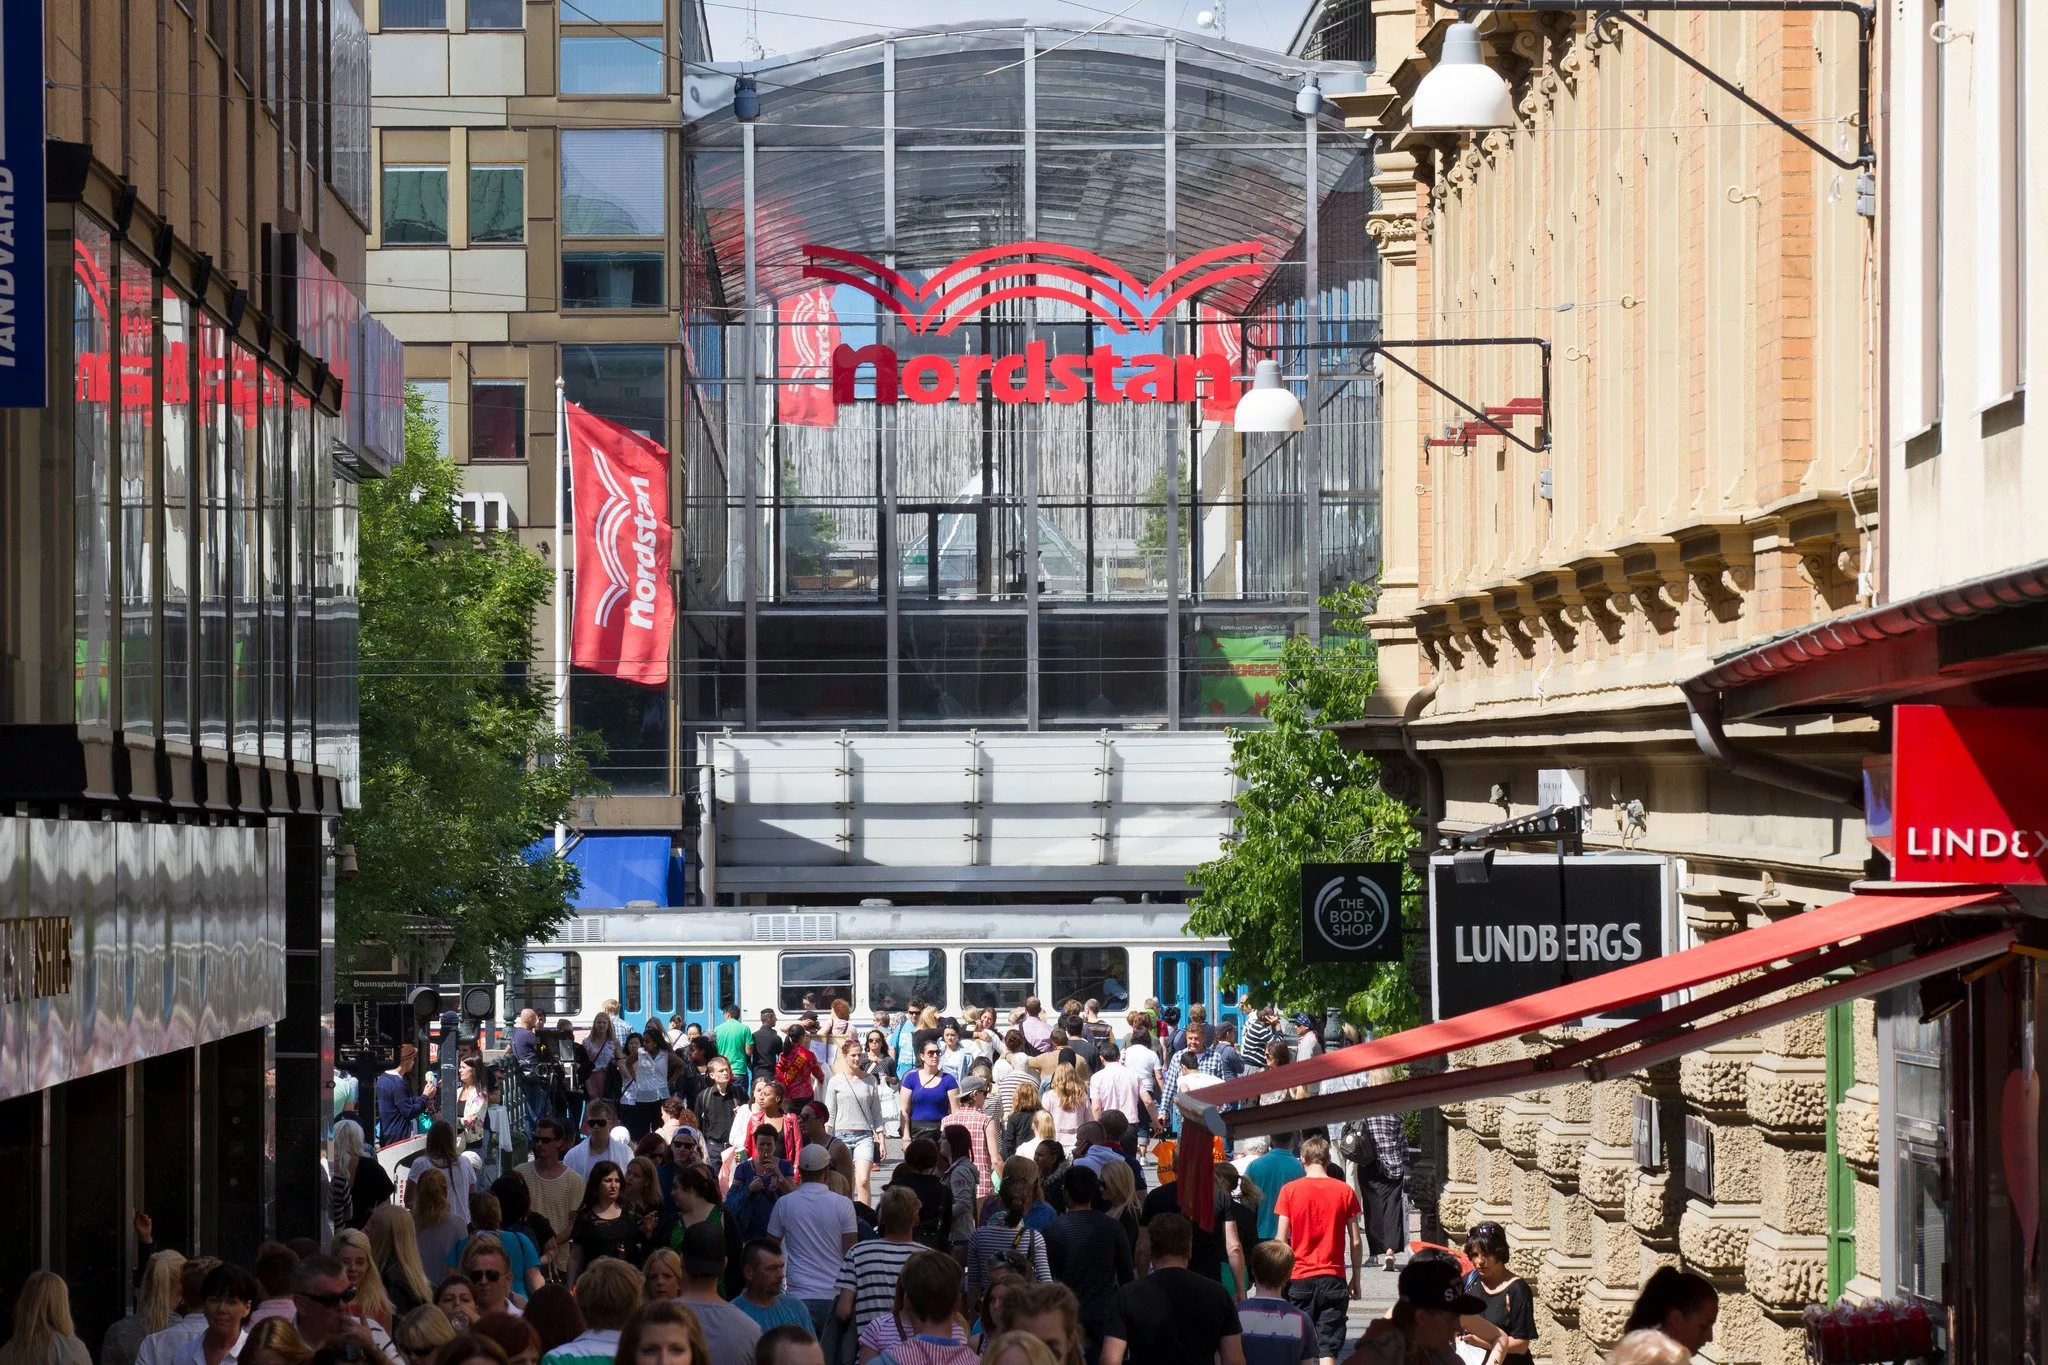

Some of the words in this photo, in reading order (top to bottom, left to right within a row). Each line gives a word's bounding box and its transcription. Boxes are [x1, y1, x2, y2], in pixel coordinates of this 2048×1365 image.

[832, 340, 1232, 405] nordstan
[629, 476, 657, 629] nordstan
[1329, 910, 1375, 923] BODY
[1338, 898, 1365, 909] THE
[1332, 924, 1374, 936] SHOP
[1455, 922, 1642, 962] LUNDBERGS
[37, 916, 73, 998] SHOES
[353, 979, 407, 989] Brunnsparken
